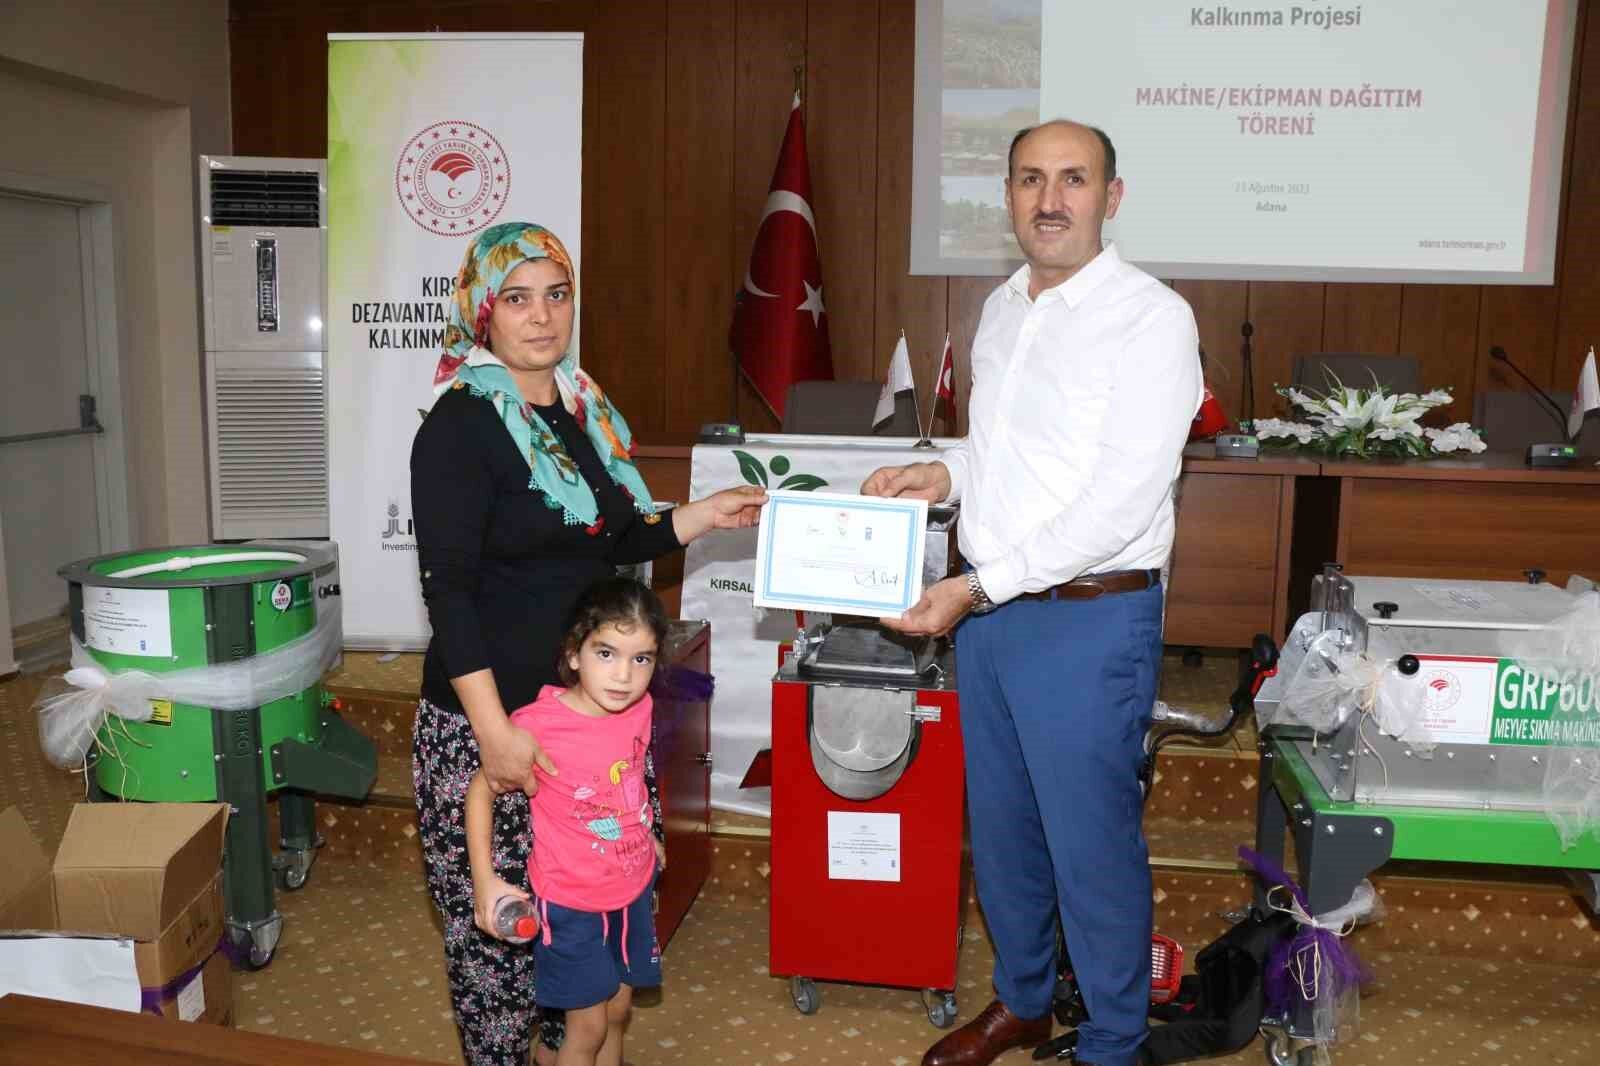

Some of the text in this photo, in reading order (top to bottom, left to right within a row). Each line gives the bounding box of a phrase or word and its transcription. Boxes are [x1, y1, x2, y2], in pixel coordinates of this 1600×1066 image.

[1191, 6, 1361, 30] Kalkınma Projesi
[1136, 83, 1422, 109] MAKİNE/EKİPMAN DAĞITIM
[1237, 112, 1315, 135] TÖRENİ
[710, 578, 754, 593] KIRSAL
[1494, 718, 1529, 739] MEYVE
